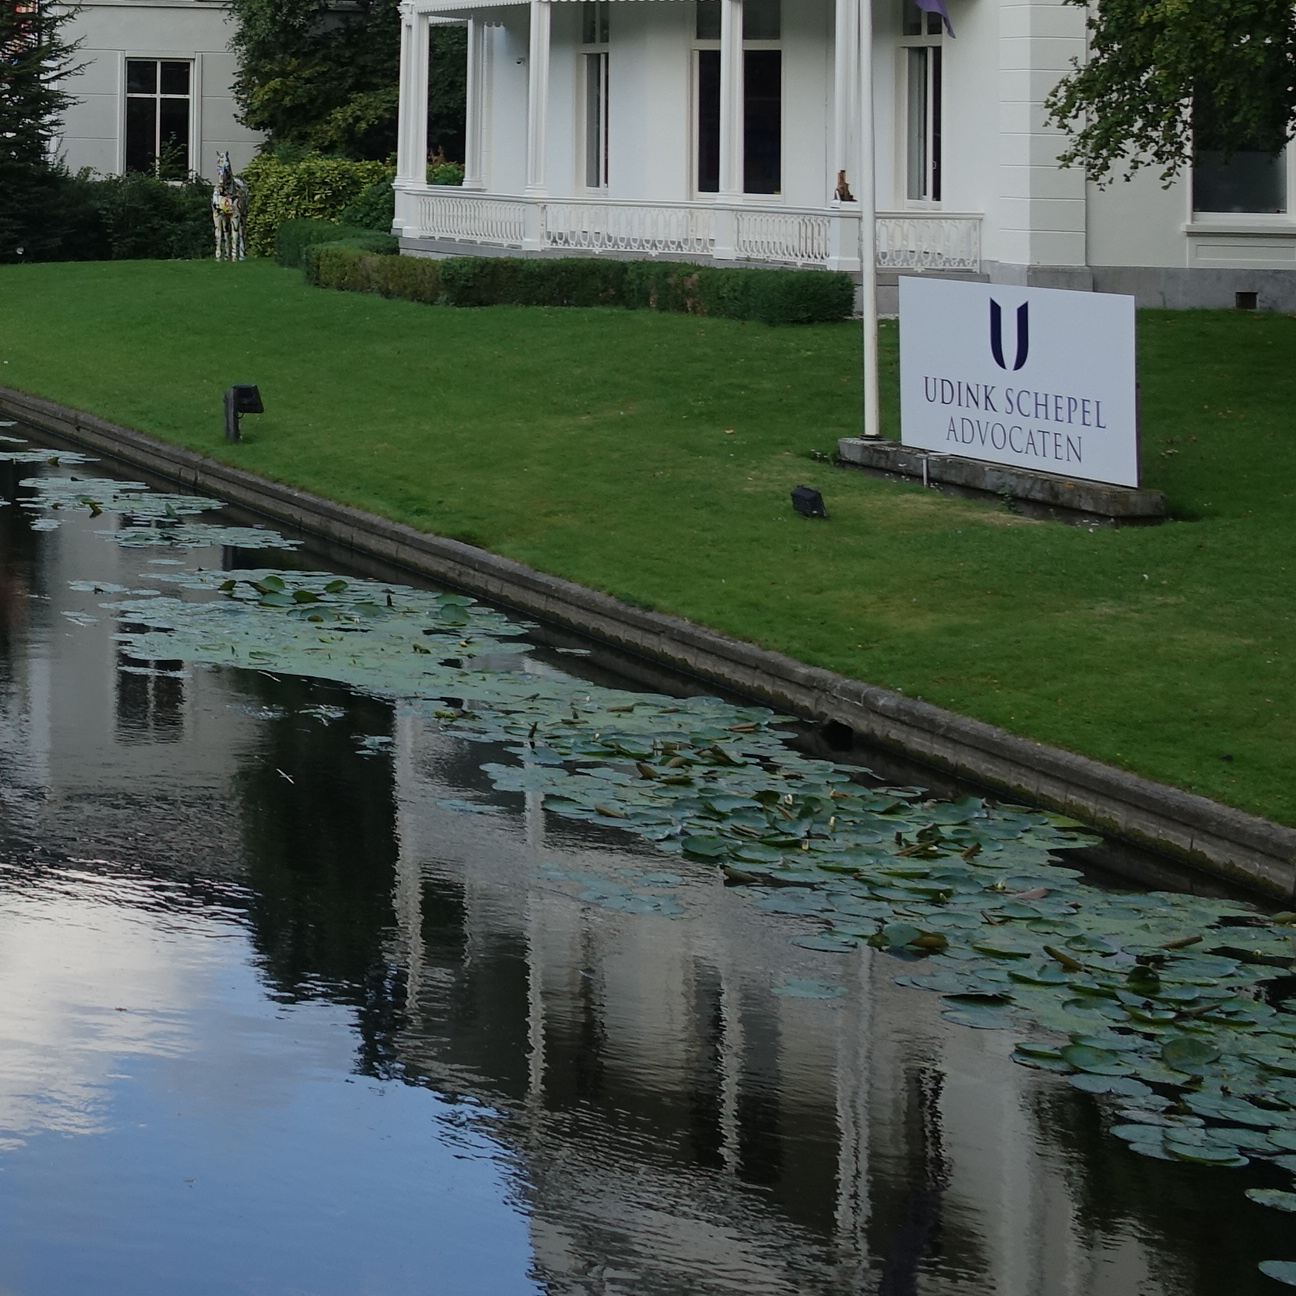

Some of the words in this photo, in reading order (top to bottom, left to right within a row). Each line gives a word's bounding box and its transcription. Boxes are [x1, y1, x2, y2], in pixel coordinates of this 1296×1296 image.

[923, 376, 998, 413] UDINK
[1005, 387, 1107, 429] SCHEPEL
[946, 415, 1083, 464] ADVOCATEN
